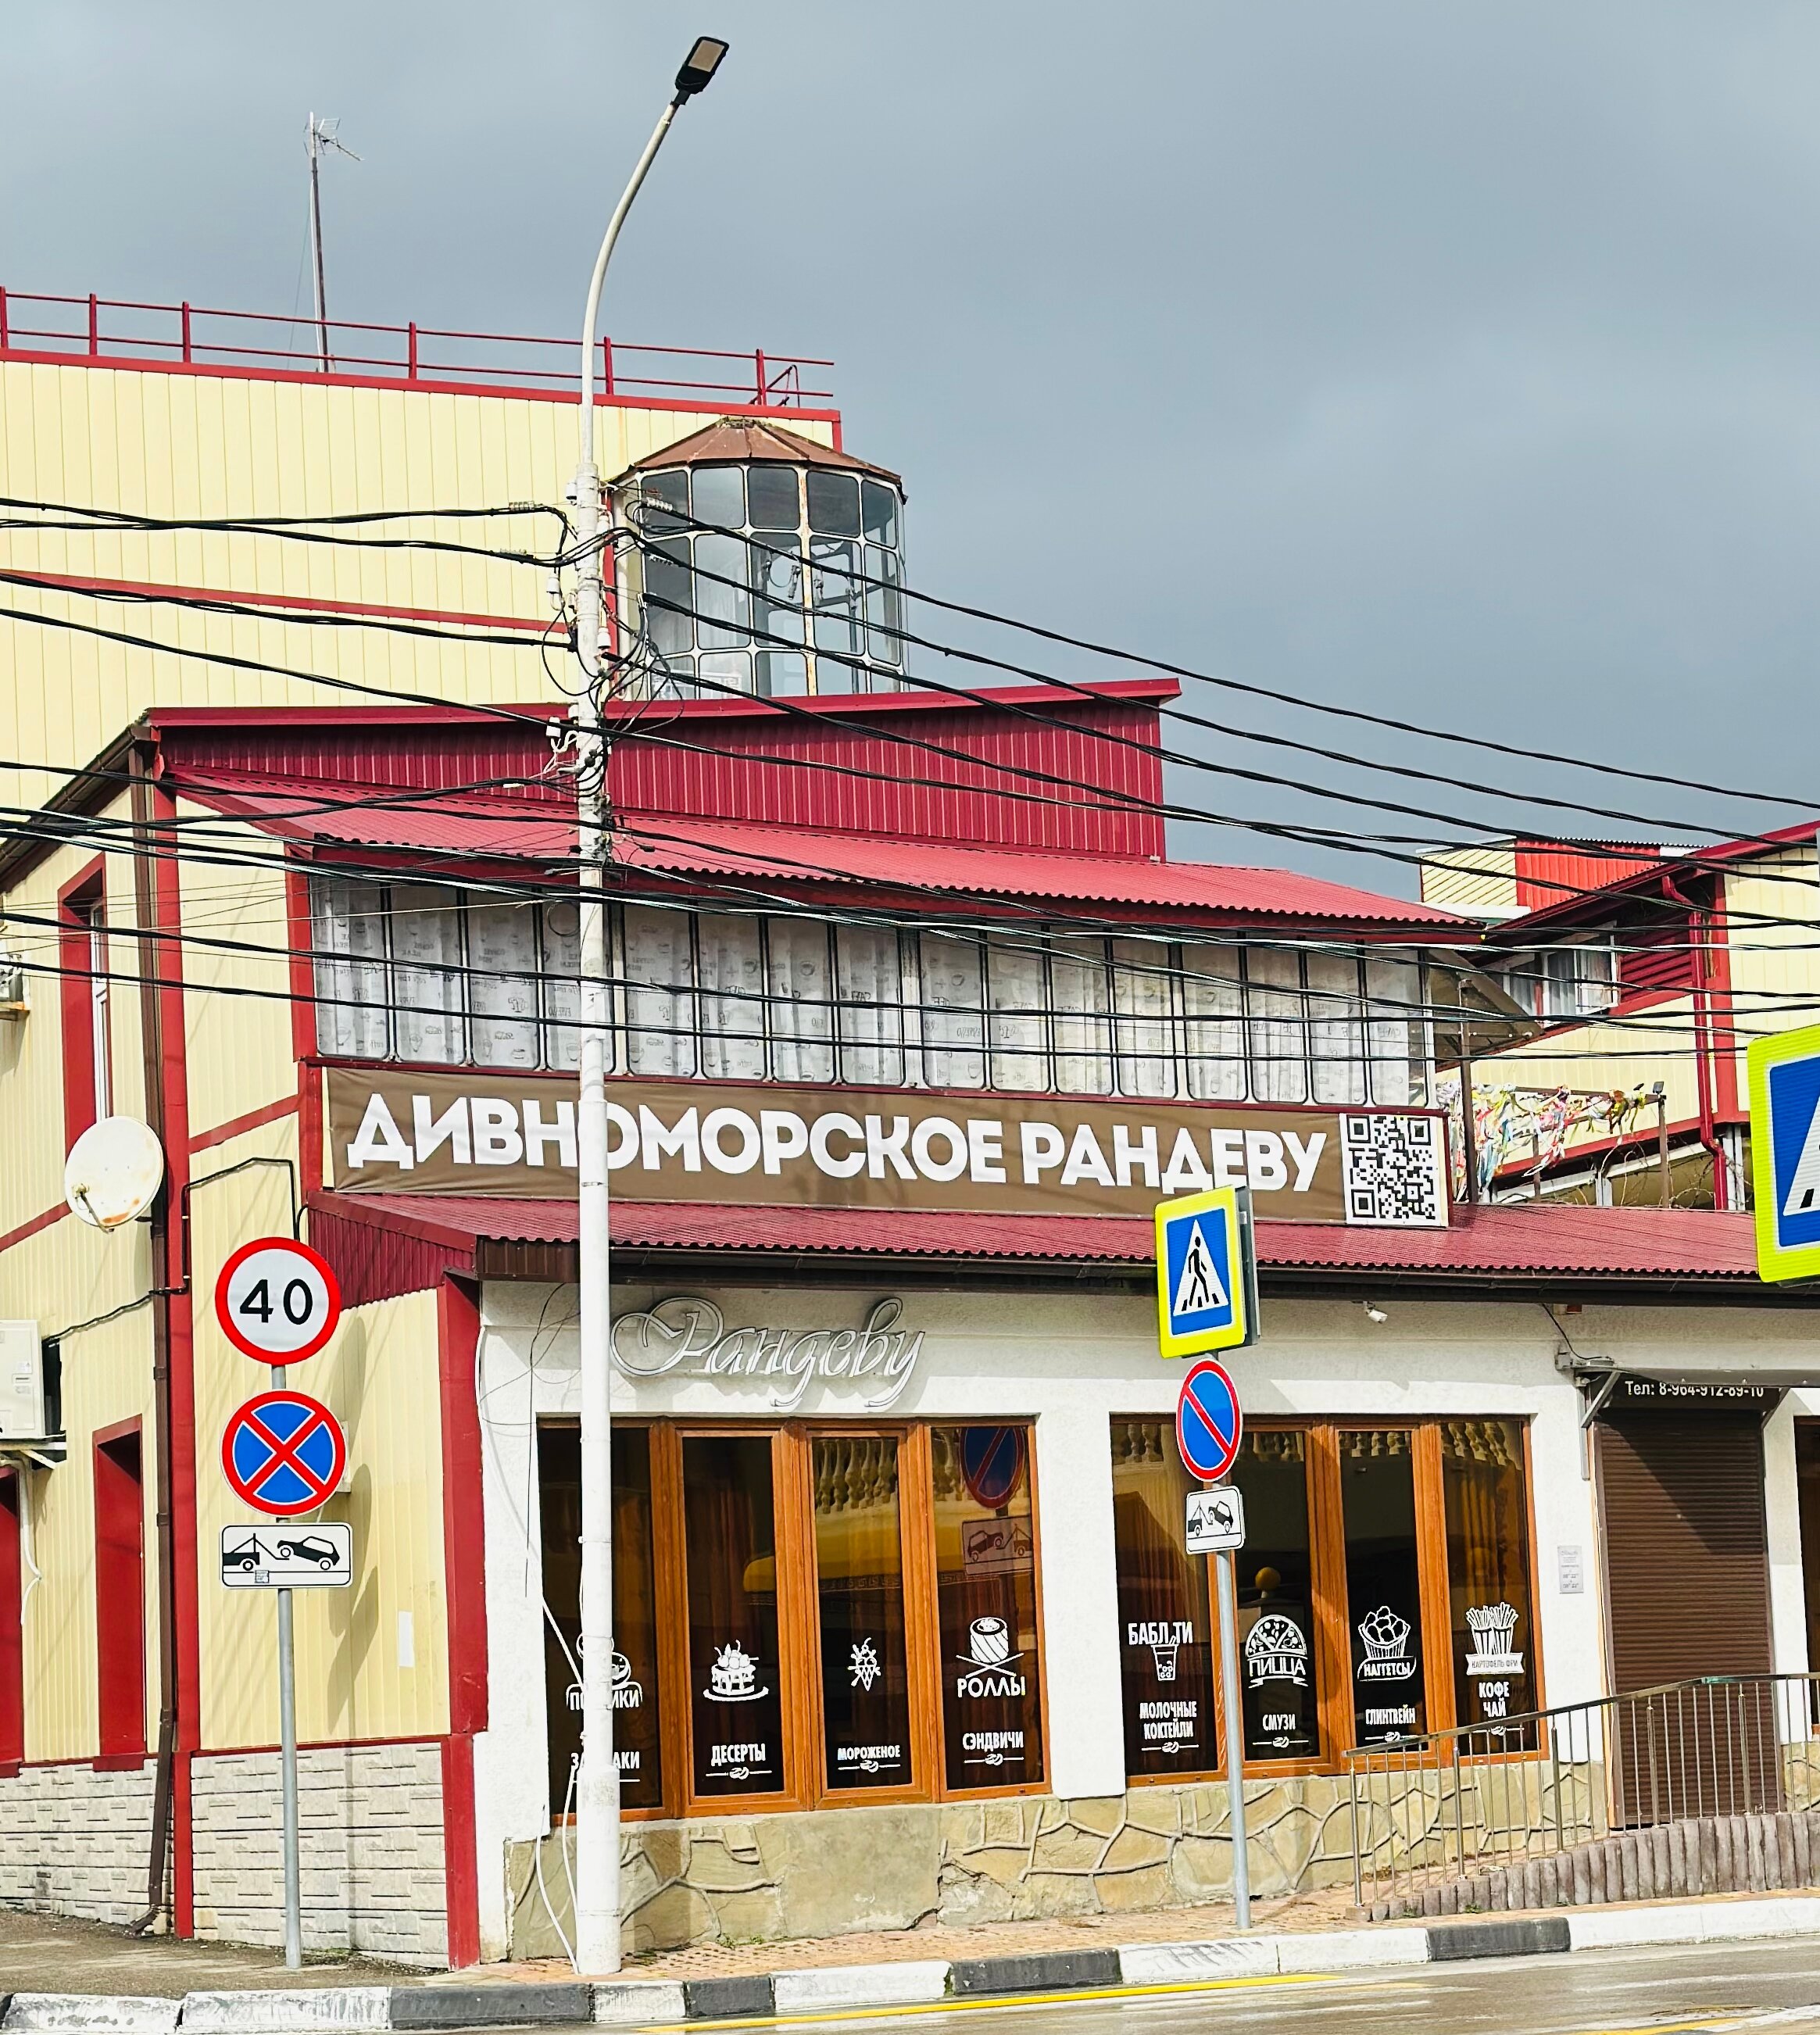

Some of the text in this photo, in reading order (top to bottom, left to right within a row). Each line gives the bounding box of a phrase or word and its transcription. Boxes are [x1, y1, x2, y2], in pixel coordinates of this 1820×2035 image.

[346, 1093, 1328, 1194] ДИВНОМОРСКОЕ РАНДЕВУ
[239, 1279, 313, 1325] 40
[610, 1296, 924, 1407] Рандеву
[1625, 1380, 1654, 1396] Тел:
[1128, 1622, 1193, 1645] БАБЛ ТИ
[1250, 1657, 1307, 1676] ПИЦЦА
[1364, 1662, 1411, 1677] НАГГЕТСЫ
[957, 1676, 1026, 1697] РОЛЛЫ
[1479, 1681, 1510, 1698] КОФЕ
[570, 1690, 639, 1711] ПИКИ
[1139, 1701, 1197, 1719] МОЛОЧНЫЕ
[1483, 1697, 1507, 1718] ЧАЙ
[1262, 1714, 1296, 1731] СМУЗИ
[1365, 1704, 1416, 1725] ГЛИНТВЕЙН
[1143, 1718, 1194, 1740] КОКТЕЙЛИ
[962, 1731, 1024, 1751] СЭНДВИЧИ
[710, 1744, 766, 1766] ДЕСЕРТЫ
[837, 1745, 900, 1760] МОРОЖЕНОЕ
